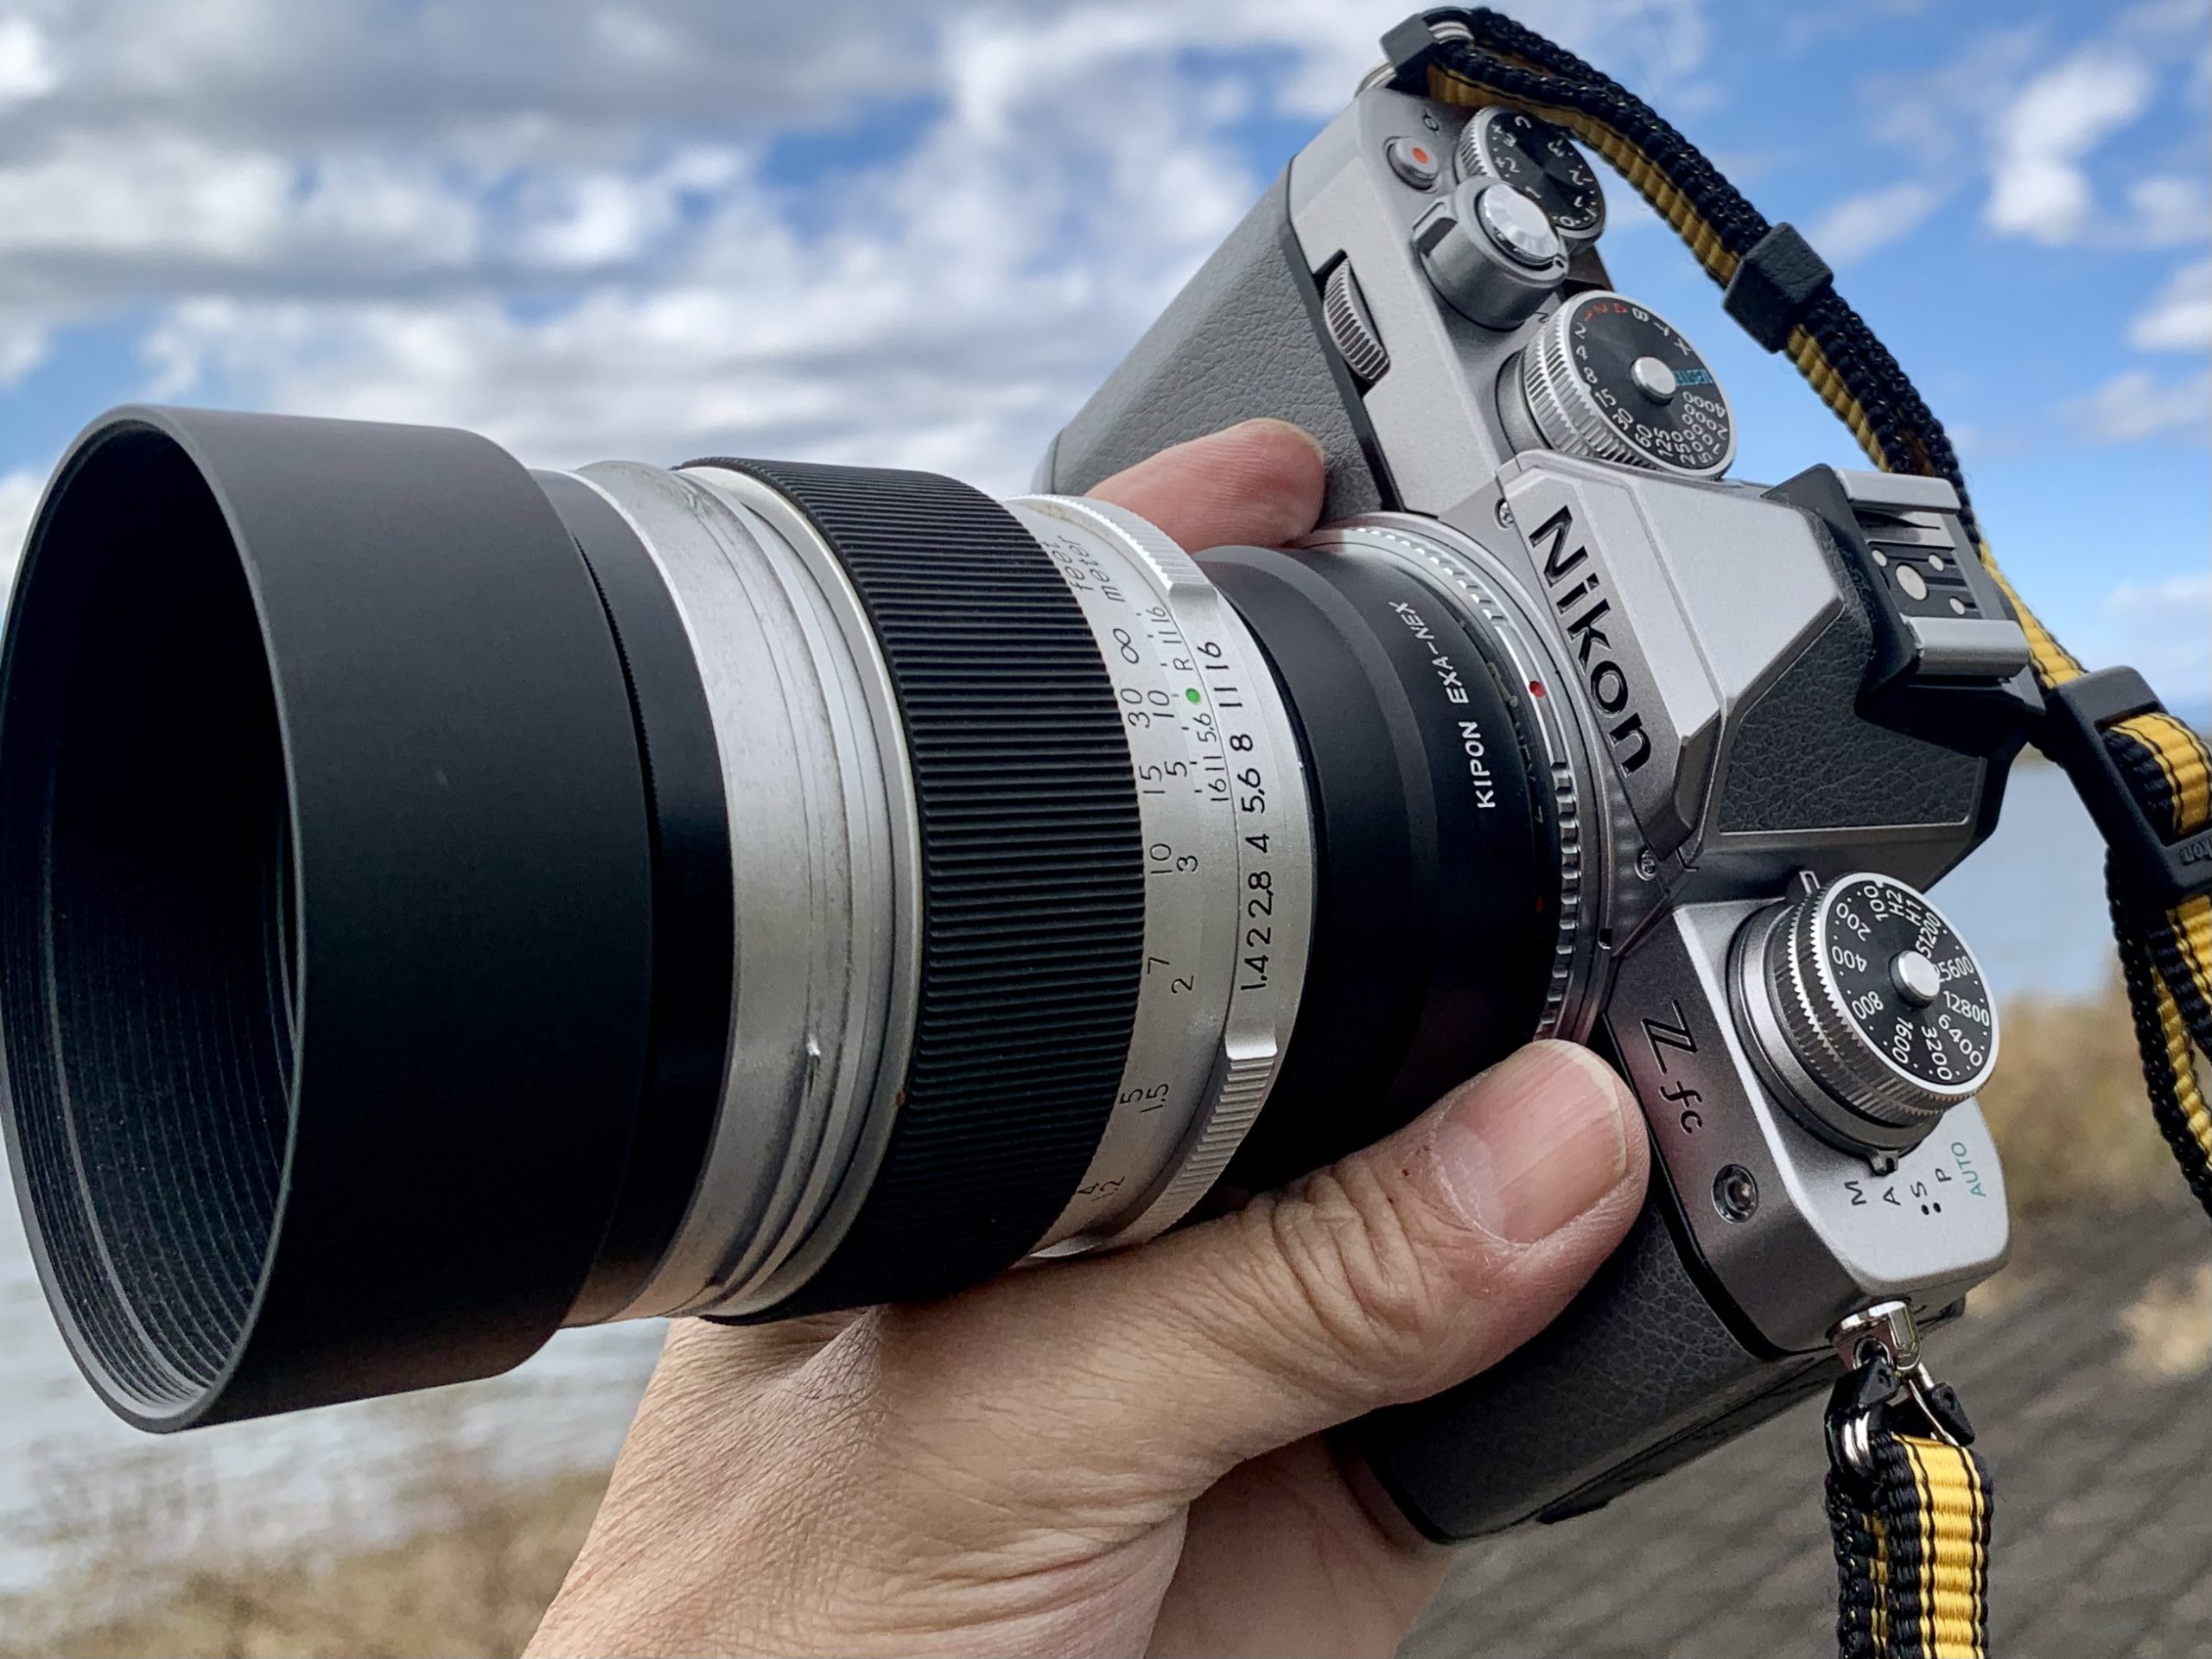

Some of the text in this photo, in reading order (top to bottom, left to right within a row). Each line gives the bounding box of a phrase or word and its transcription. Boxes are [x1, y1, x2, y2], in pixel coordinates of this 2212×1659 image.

[1574, 322, 1586, 340] 2
[1653, 322, 1669, 337] T
[1576, 346, 1588, 360] 4
[1674, 338, 1692, 356] X
[1583, 367, 1598, 384] 8
[1594, 388, 1617, 408] 15
[1682, 391, 1726, 418] 4000
[1612, 408, 1634, 430] 30
[1684, 404, 1728, 441] 2000
[1635, 424, 1653, 448] 60
[1654, 428, 1674, 457] 125
[1681, 413, 1720, 454] 1000
[1683, 429, 1713, 463] 500
[1671, 431, 1696, 465] 250
[1040, 541, 1094, 591] feet
[1058, 535, 1126, 603] meter
[1146, 607, 1170, 622] 16
[1529, 505, 1651, 778] Nikon
[1173, 658, 1193, 671] R
[1197, 641, 1230, 670] 16
[1121, 689, 1150, 728] 30
[1147, 690, 1174, 717] 10
[1214, 687, 1243, 708] 11
[1389, 601, 1496, 808] KIPON EXA-NEX
[1230, 734, 1253, 752] 8
[1139, 766, 1166, 793] 15
[1165, 761, 1187, 778] 5
[1208, 778, 1230, 801] 16
[1245, 833, 1269, 854] 4
[1150, 843, 1173, 874] 10
[1177, 855, 1198, 873] 3
[1864, 886, 1889, 922] 100
[1836, 903, 1872, 942] 200
[1916, 912, 1942, 959] 51200
[1246, 926, 1271, 947] 2
[1147, 957, 1170, 974] 7
[1241, 954, 1269, 991] 1.4
[1832, 945, 1867, 973] 400
[1172, 976, 1194, 995] 2
[1852, 990, 1884, 1020] 800
[1943, 990, 1990, 1027] 12800
[1891, 1017, 1914, 1065] 1600
[1922, 1026, 1953, 1080] 3200
[1938, 1014, 1983, 1067] 6400
[1641, 999, 1703, 1135] Z fc
[1119, 1089, 1143, 1104] 5
[1935, 1168, 1952, 1183] P
[1951, 1141, 1986, 1197] AUTO
[1844, 1180, 1867, 1206] M
[1882, 1186, 1901, 1206] A
[1910, 1181, 1928, 1198] S
